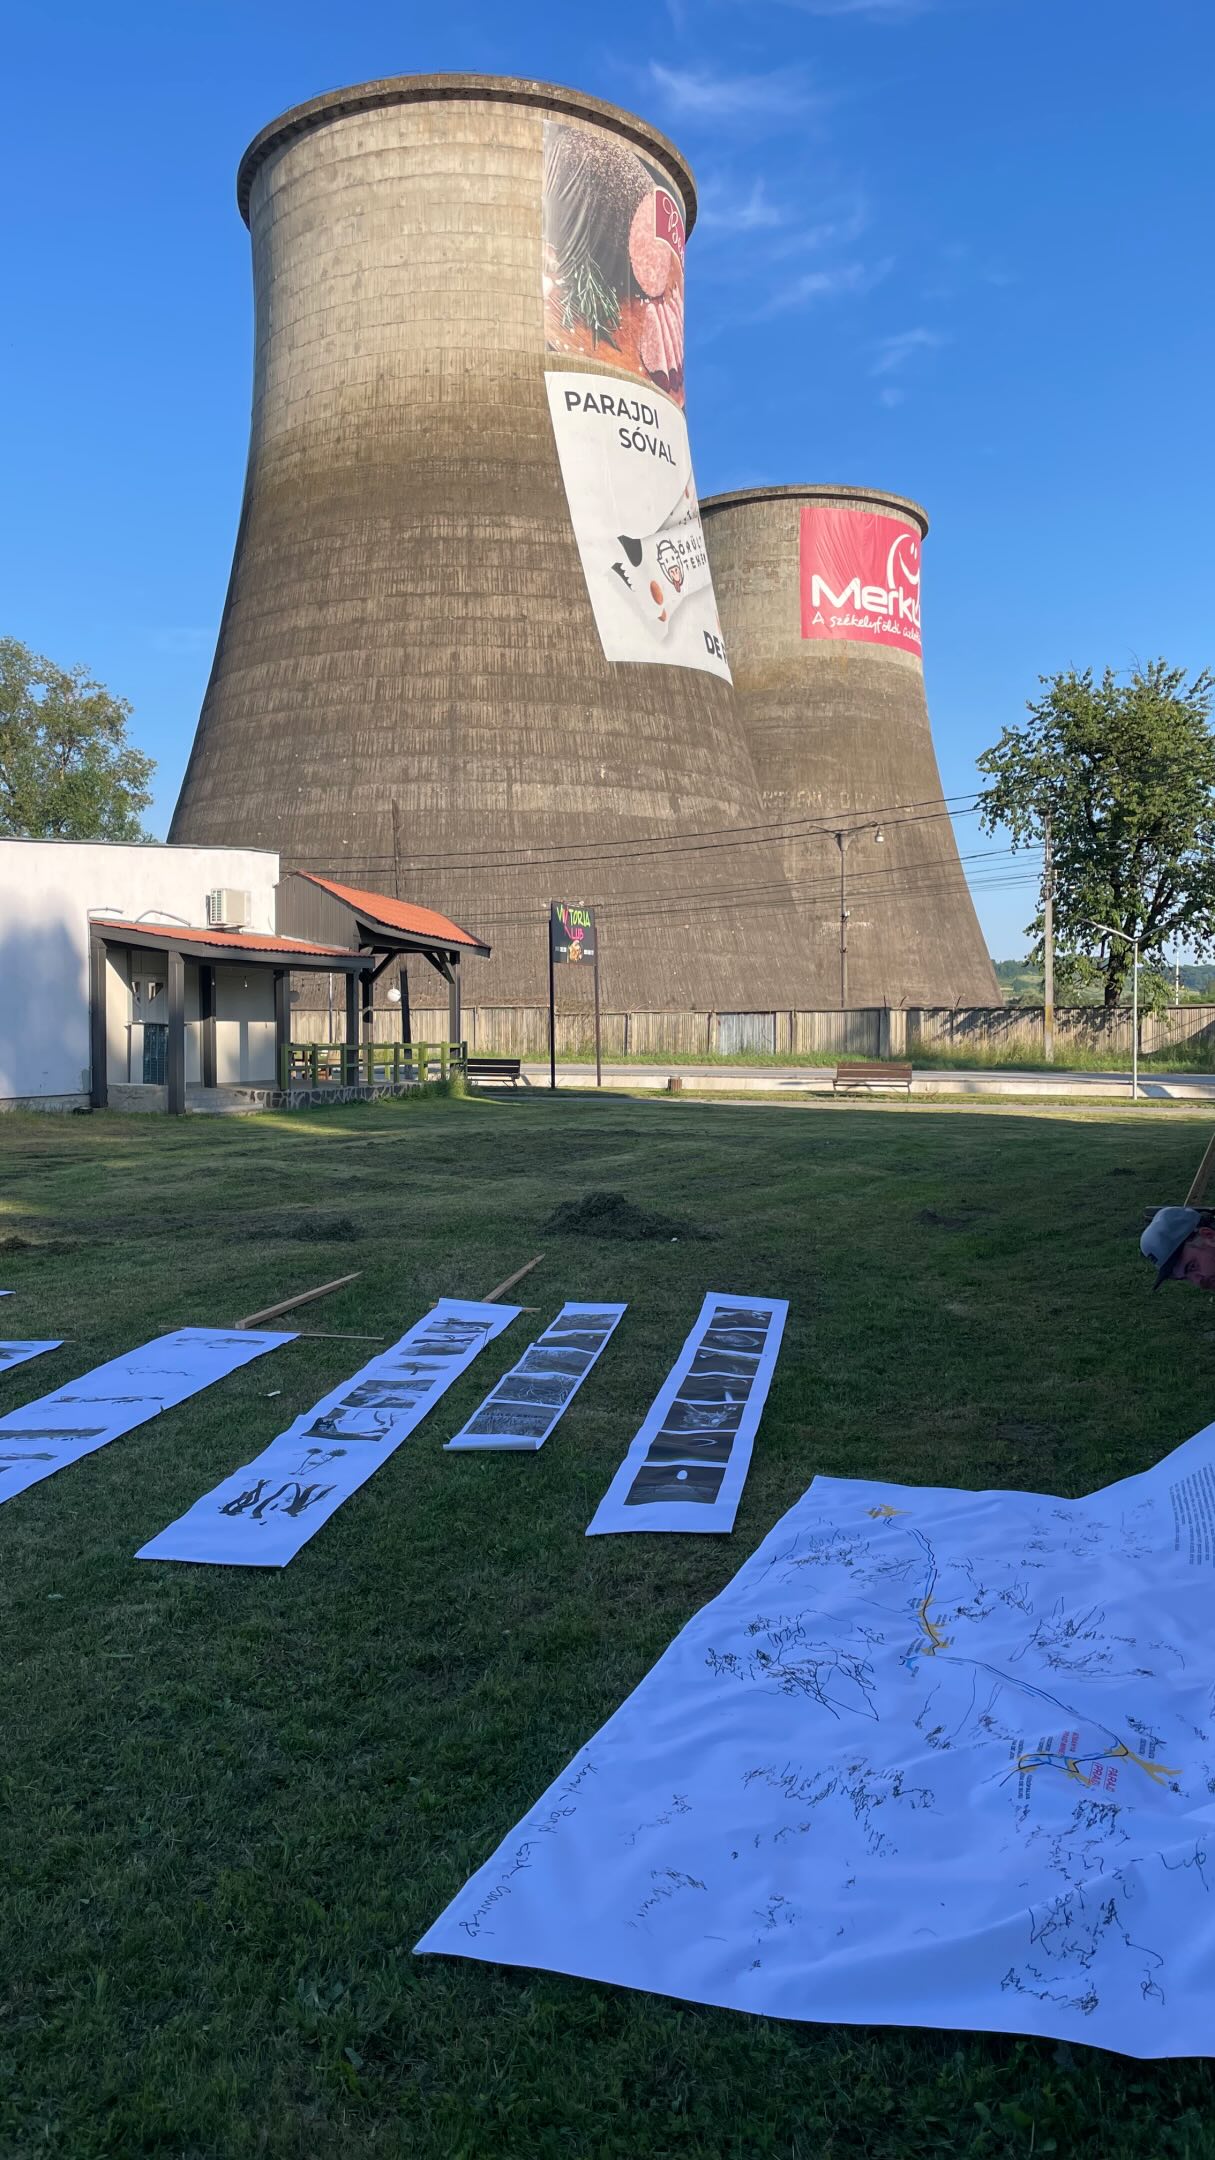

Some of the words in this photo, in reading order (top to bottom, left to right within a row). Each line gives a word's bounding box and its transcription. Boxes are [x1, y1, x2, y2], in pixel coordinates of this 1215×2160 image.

[564, 391, 659, 429] PARAJDI
[618, 427, 677, 466] SÓVAL
[812, 611, 825, 625] A
[830, 613, 902, 635] székelyföldi
